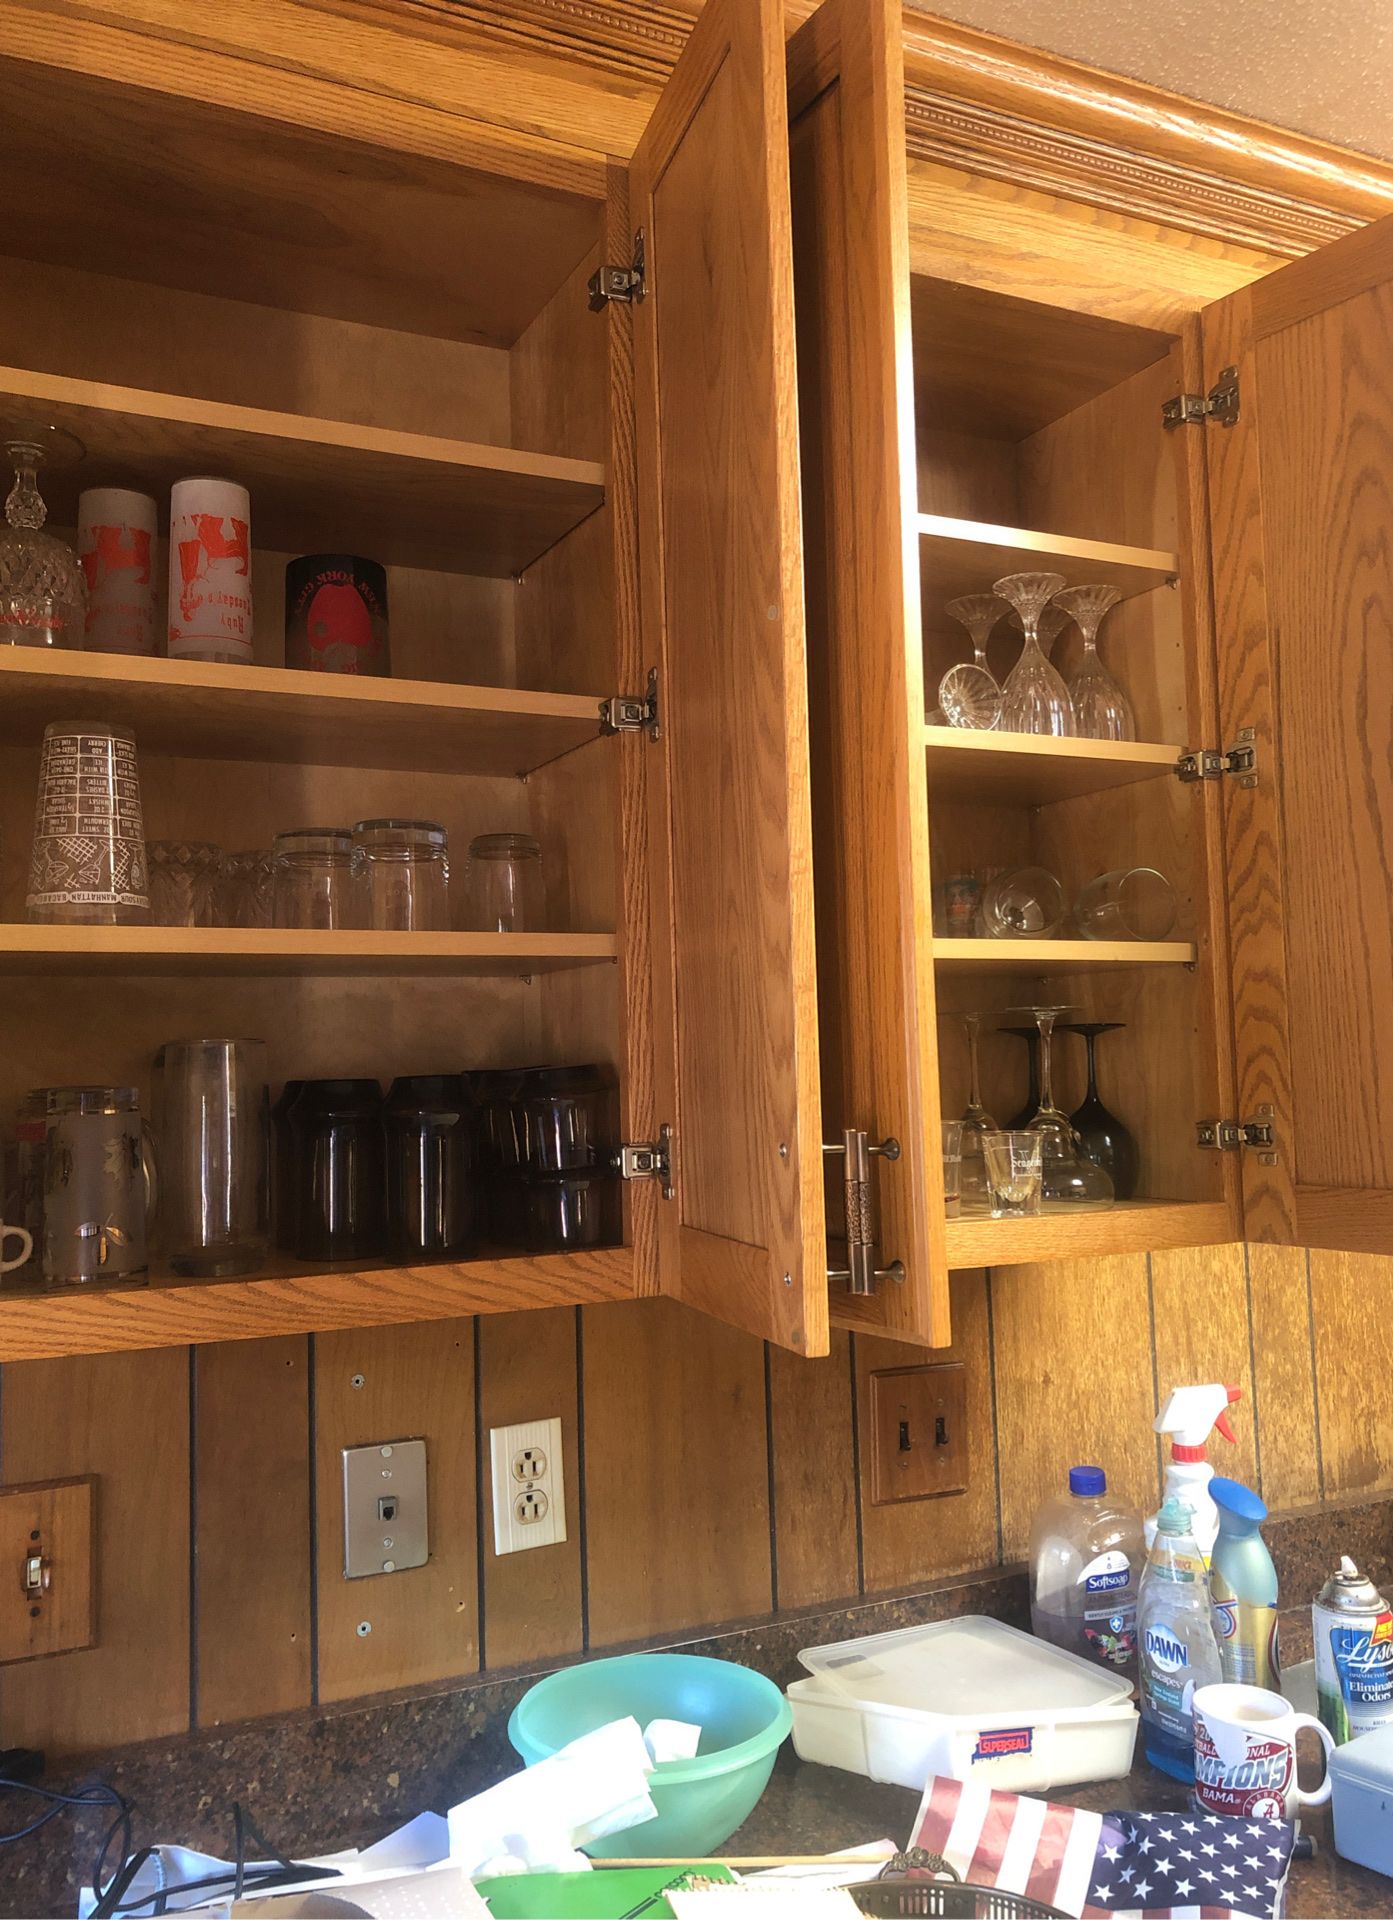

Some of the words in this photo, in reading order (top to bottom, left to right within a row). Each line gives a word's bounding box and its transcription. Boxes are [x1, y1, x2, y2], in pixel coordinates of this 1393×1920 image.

[221, 614, 244, 634] Ruby
[72, 893, 117, 901] MANHATTAN
[1089, 1574, 1128, 1589] Softsoap
[1146, 1629, 1188, 1667] DAWN
[1336, 1637, 1393, 1674] Lyso
[1361, 1692, 1391, 1703] Odors
[982, 1738, 1027, 1752] SUPERSEAL
[1196, 1750, 1288, 1789] MPIONS
[1202, 1788, 1235, 1804] BAMA
